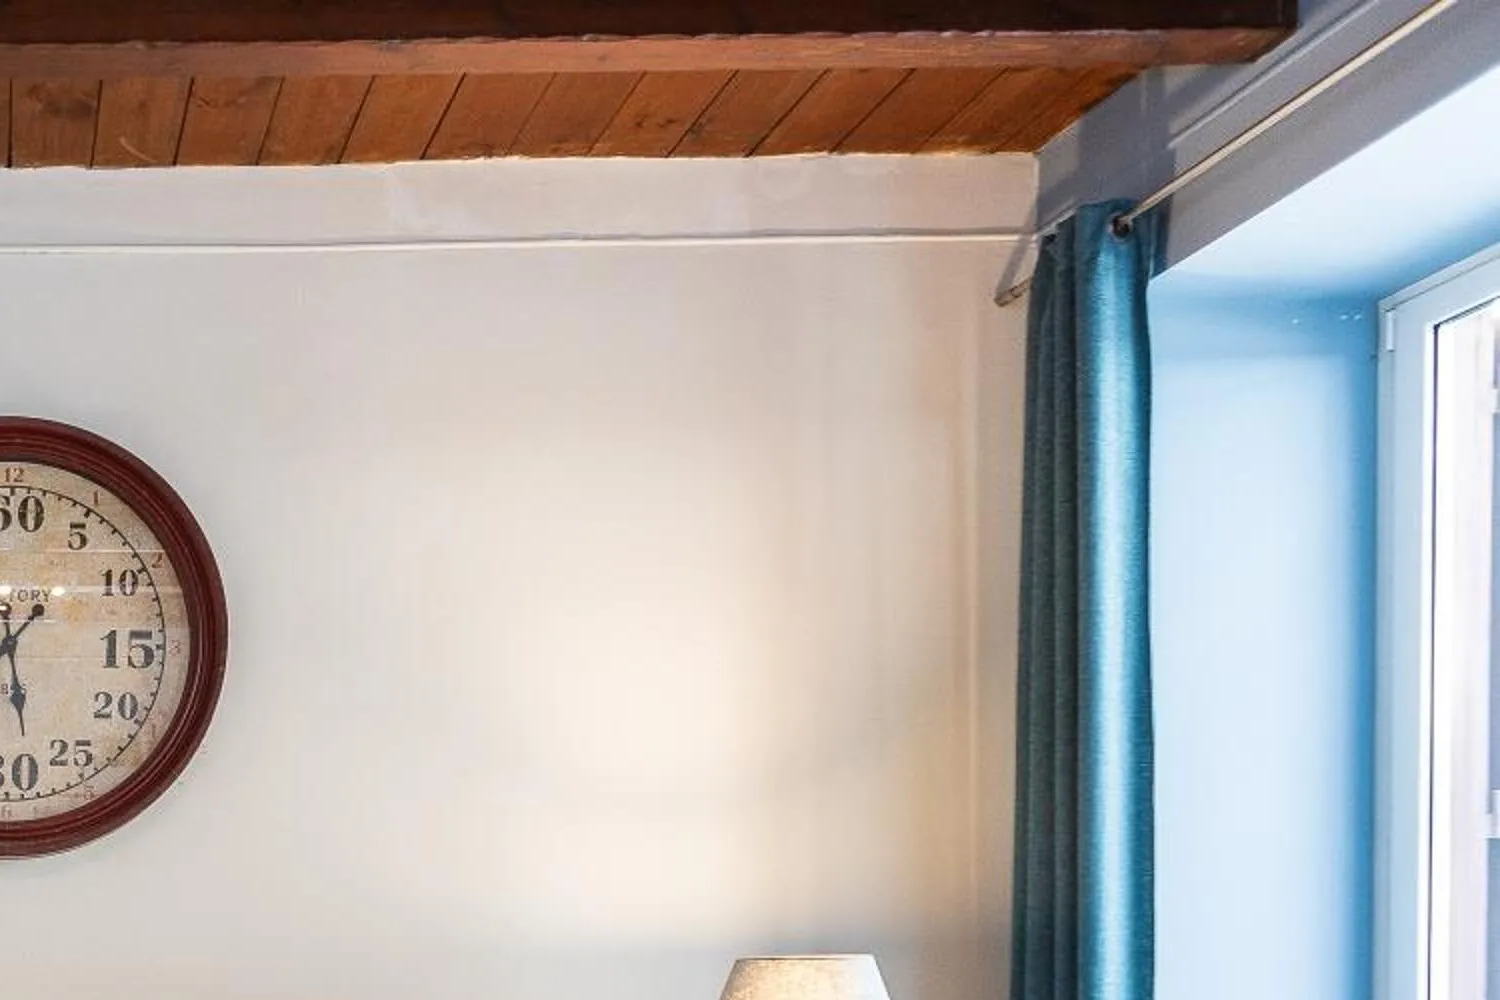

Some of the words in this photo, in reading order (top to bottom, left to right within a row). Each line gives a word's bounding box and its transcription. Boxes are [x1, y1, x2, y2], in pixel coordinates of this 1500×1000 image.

[4, 467, 25, 483] 12
[68, 522, 88, 551] 5
[101, 569, 139, 597] 10
[100, 629, 155, 669] 15
[93, 691, 139, 721] 20
[49, 739, 94, 767] 25
